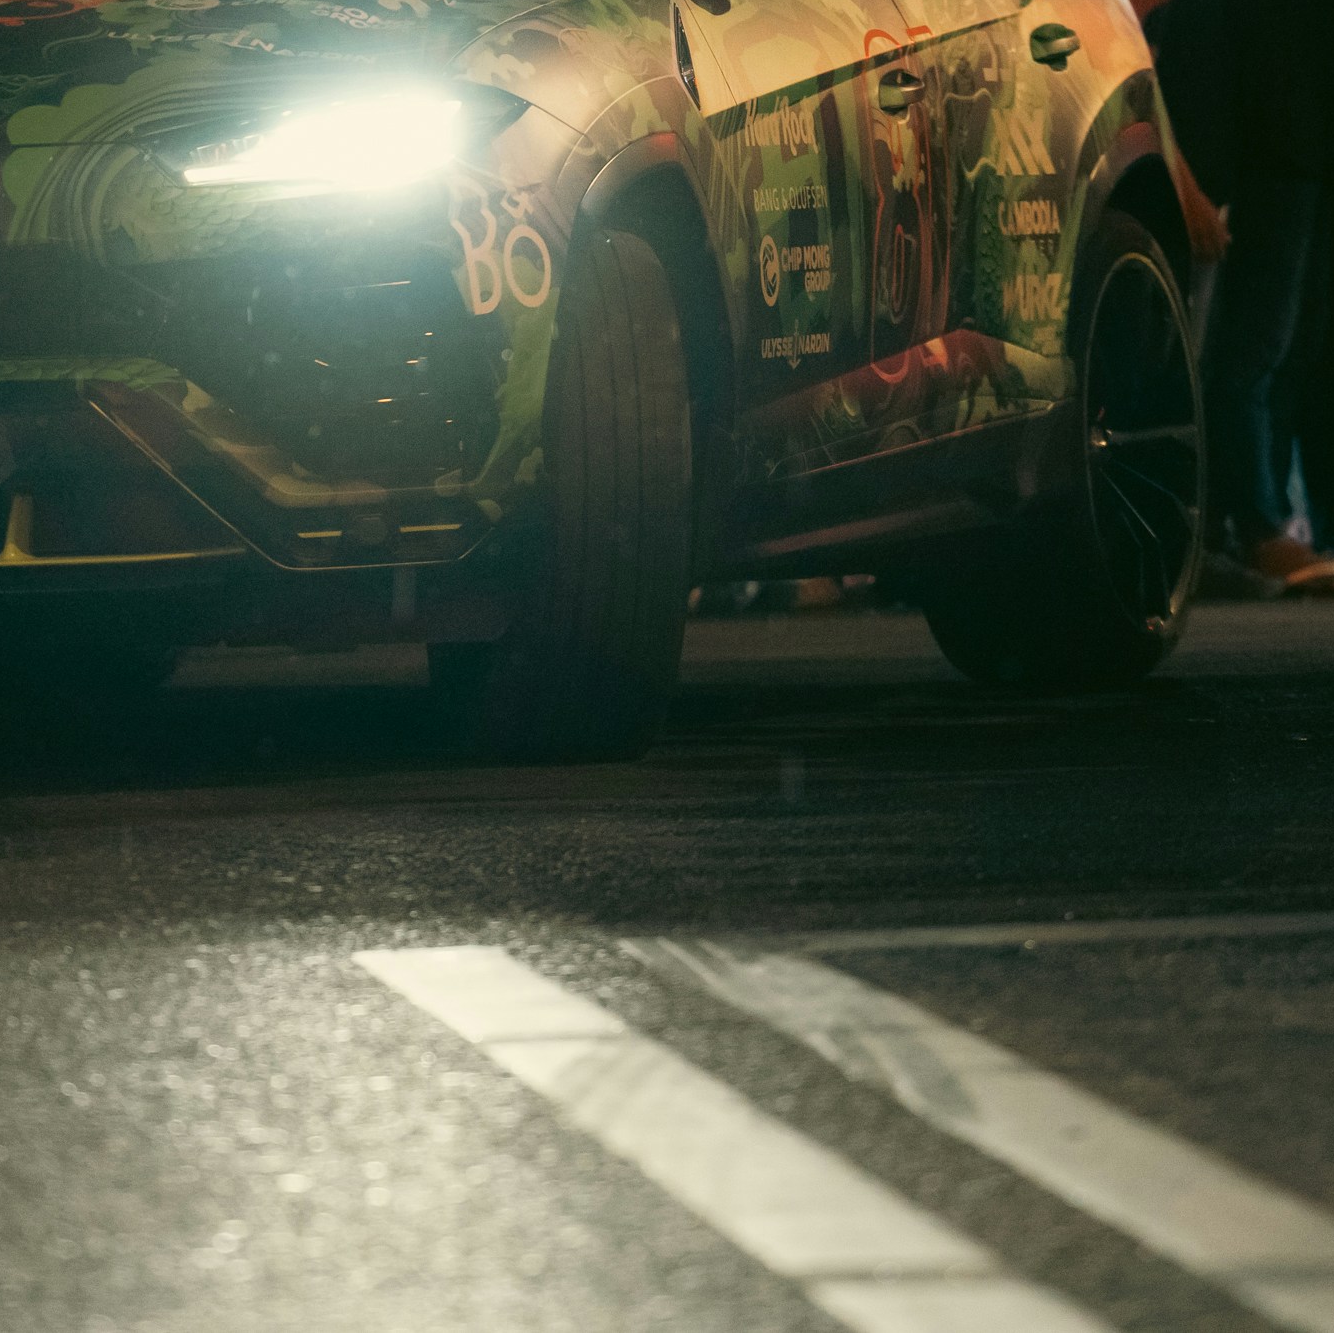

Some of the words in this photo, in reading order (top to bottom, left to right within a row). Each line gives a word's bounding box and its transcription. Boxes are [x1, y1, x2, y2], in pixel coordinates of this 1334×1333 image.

[779, 96, 819, 156] Rock
[753, 187, 779, 212] BANG
[788, 185, 828, 210] OLUFSEN
[998, 200, 1061, 235] CAMBODIA
[781, 247, 802, 272] CHIP
[803, 244, 830, 269] MONG
[804, 270, 831, 293] GROUP
[761, 335, 793, 359] ULYSSE
[797, 332, 831, 356] NARDIN
